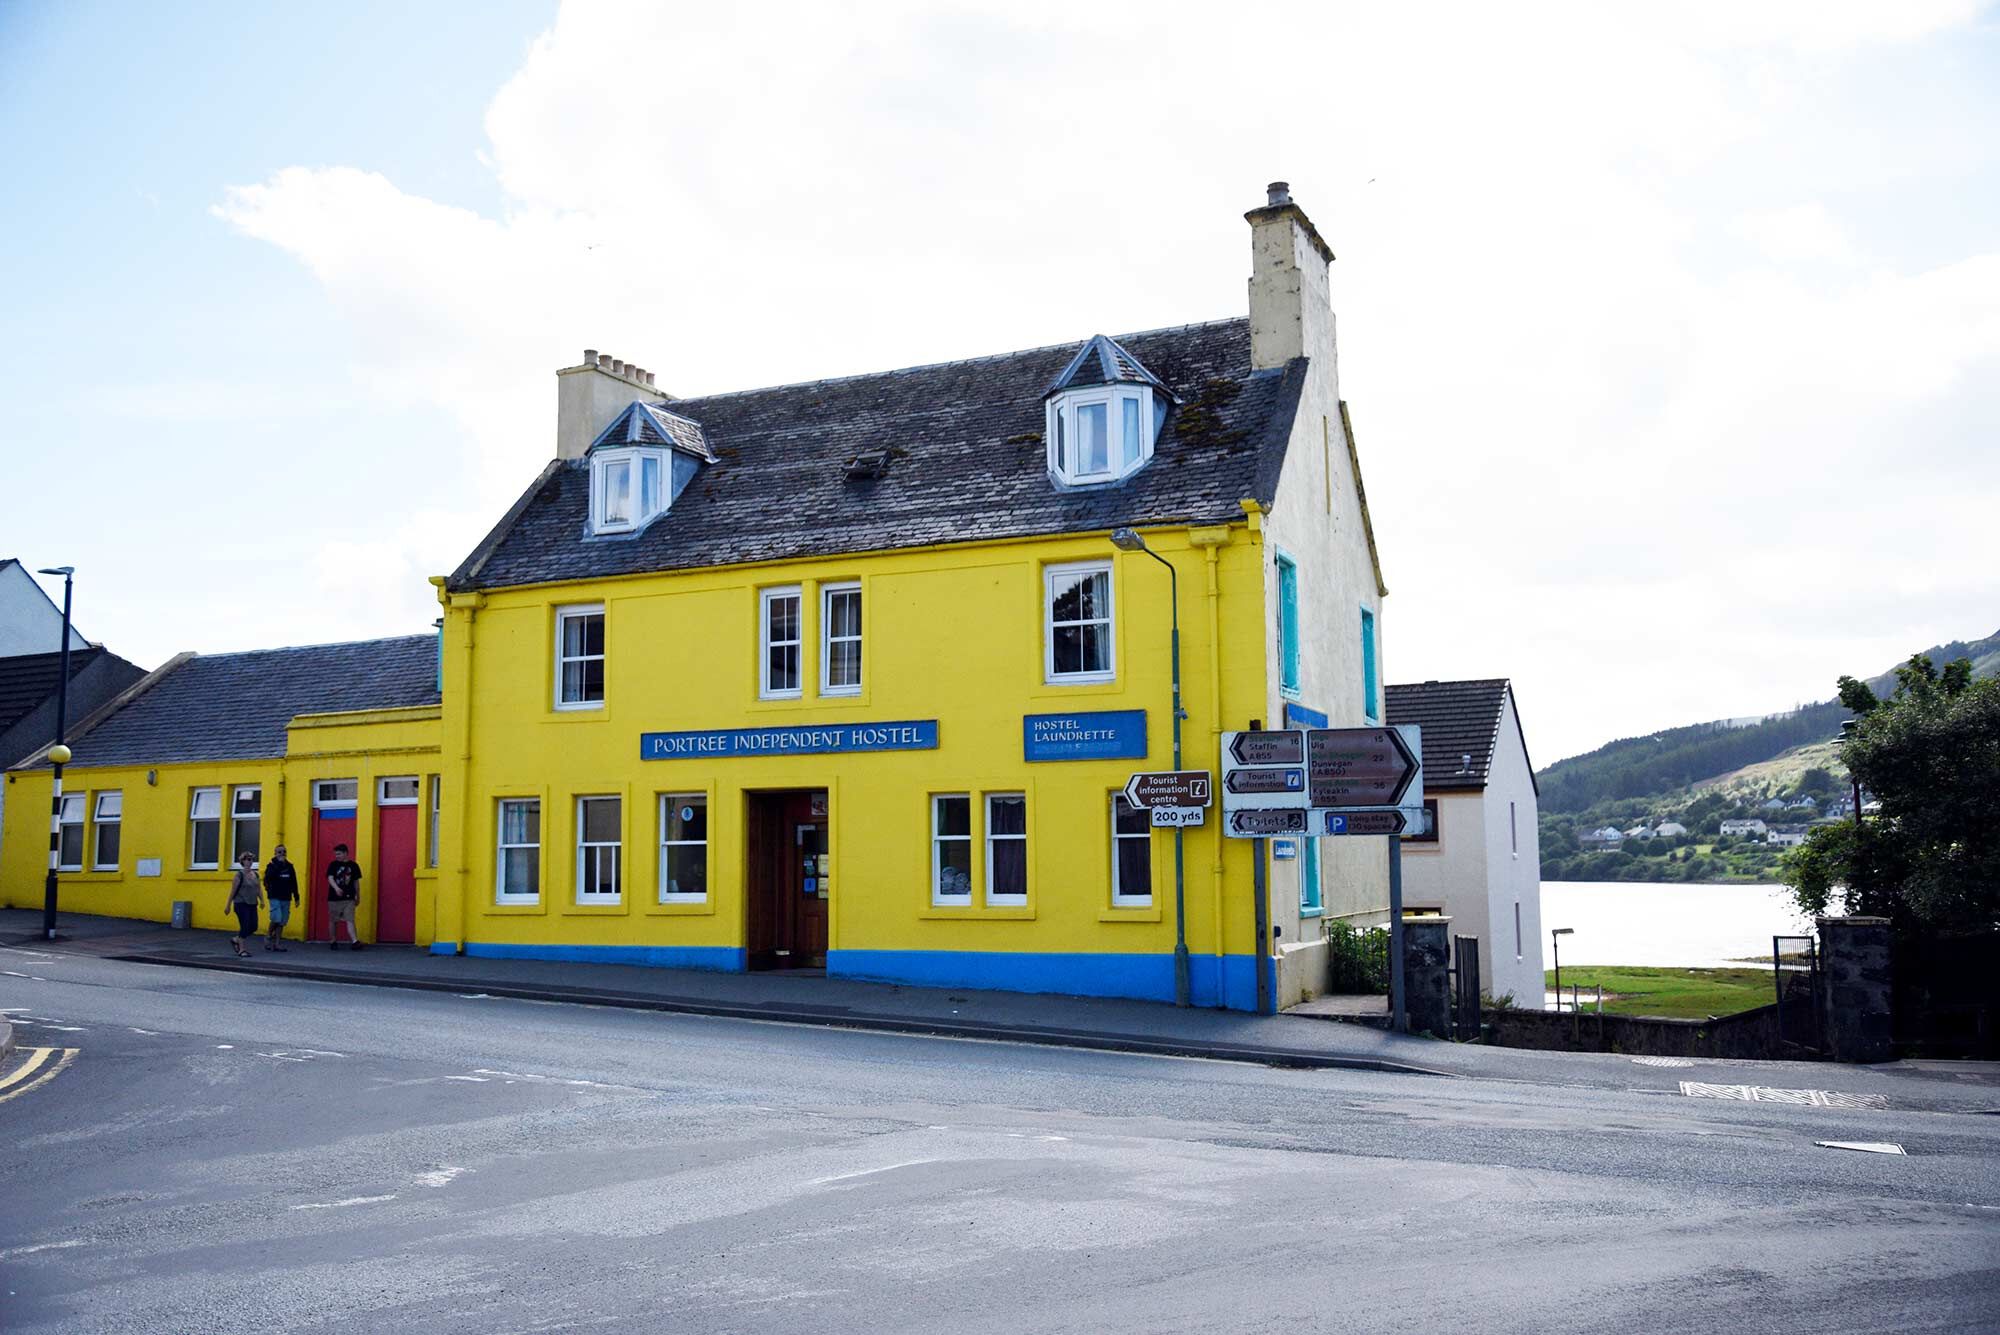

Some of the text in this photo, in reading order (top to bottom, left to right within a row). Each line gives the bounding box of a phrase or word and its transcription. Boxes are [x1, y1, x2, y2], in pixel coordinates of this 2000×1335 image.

[1034, 720, 1080, 731] HOSTEL
[654, 727, 923, 752] PORTREE INDEPENDENT HOSTEL
[1034, 730, 1116, 742] LAUNDRETTE
[1311, 741, 1325, 750] Uig
[1372, 754, 1384, 762] 22
[1312, 760, 1353, 769] Dunvegan
[1148, 775, 1178, 785] Tourist
[1239, 781, 1286, 789] information
[1140, 785, 1188, 794] information
[1155, 811, 1201, 823] 200 yds
[1246, 816, 1286, 826] Toilets
